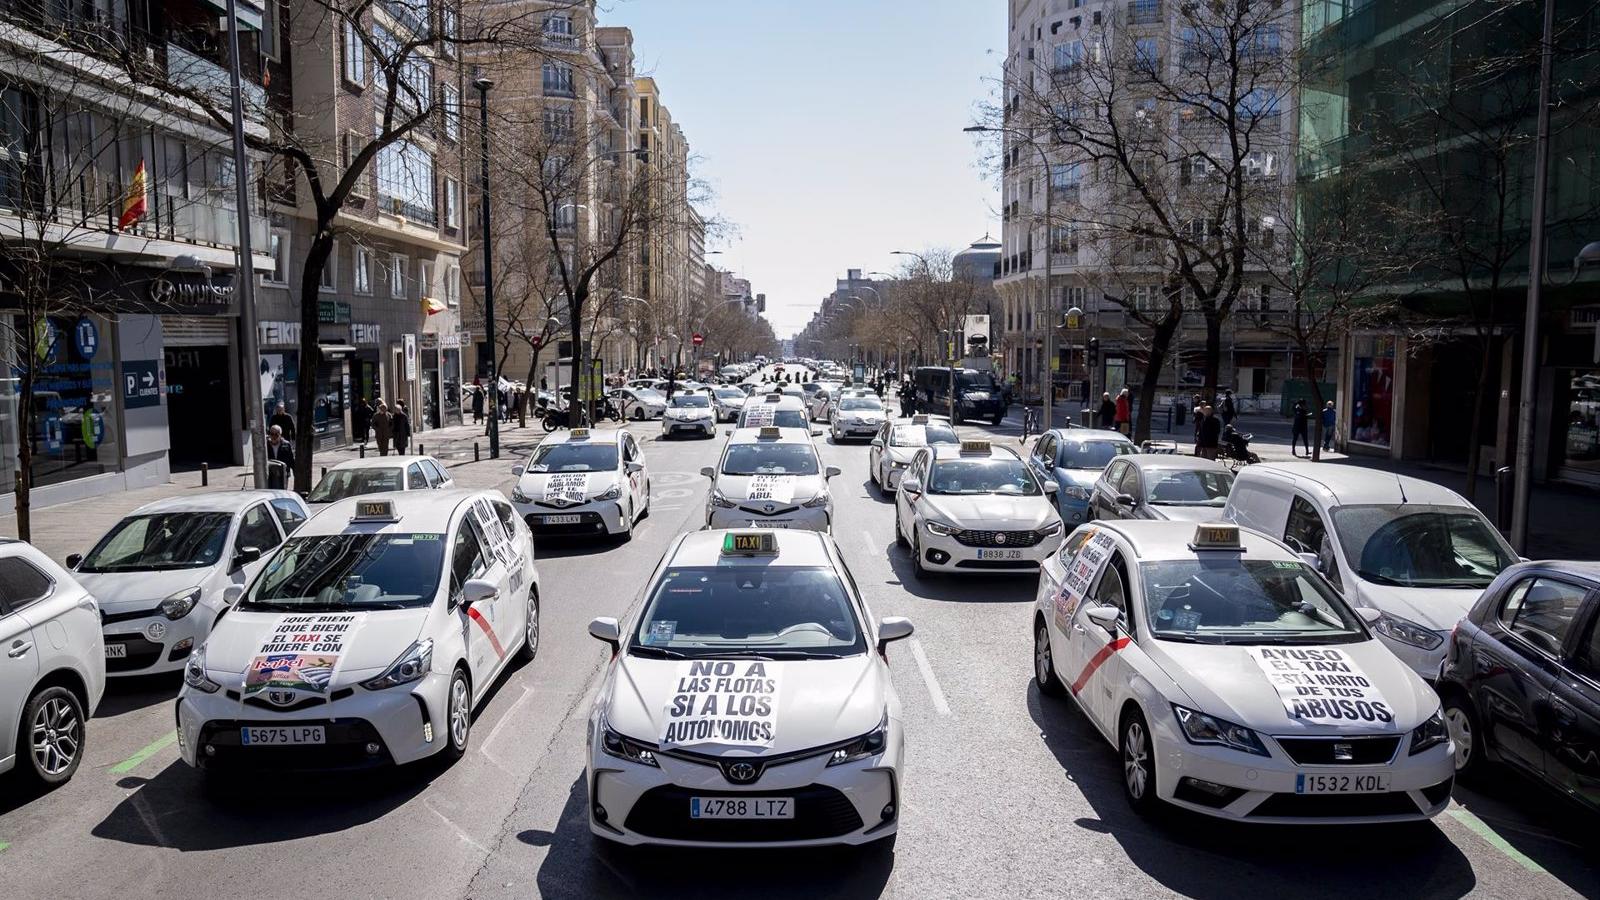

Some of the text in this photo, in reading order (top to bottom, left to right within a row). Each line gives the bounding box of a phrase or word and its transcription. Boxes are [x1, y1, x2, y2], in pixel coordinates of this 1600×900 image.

[127, 375, 135, 395] P
[546, 491, 584, 501] ESPEAMOS
[365, 504, 384, 514] TAXI
[1210, 530, 1231, 541] TAXI
[736, 536, 760, 549] TAXI
[983, 551, 1003, 559] 8838
[310, 624, 349, 632] BIEN!
[271, 634, 342, 643] EL TAXI SE
[260, 643, 343, 653] MUERE CON
[1261, 648, 1343, 661] AYUSO
[689, 661, 766, 677] NO A
[1272, 660, 1351, 673] EL TAXI
[677, 677, 776, 694] LAS FLOTAS
[1315, 674, 1370, 688] HARTO
[1296, 686, 1364, 698] DE TUS
[670, 694, 772, 717] SI A LOS
[1292, 699, 1392, 723] ABUSOS
[251, 728, 321, 743] 5675 LPG
[1309, 775, 1385, 792] 1532 KDL
[704, 800, 788, 816] 4788 LTZ
